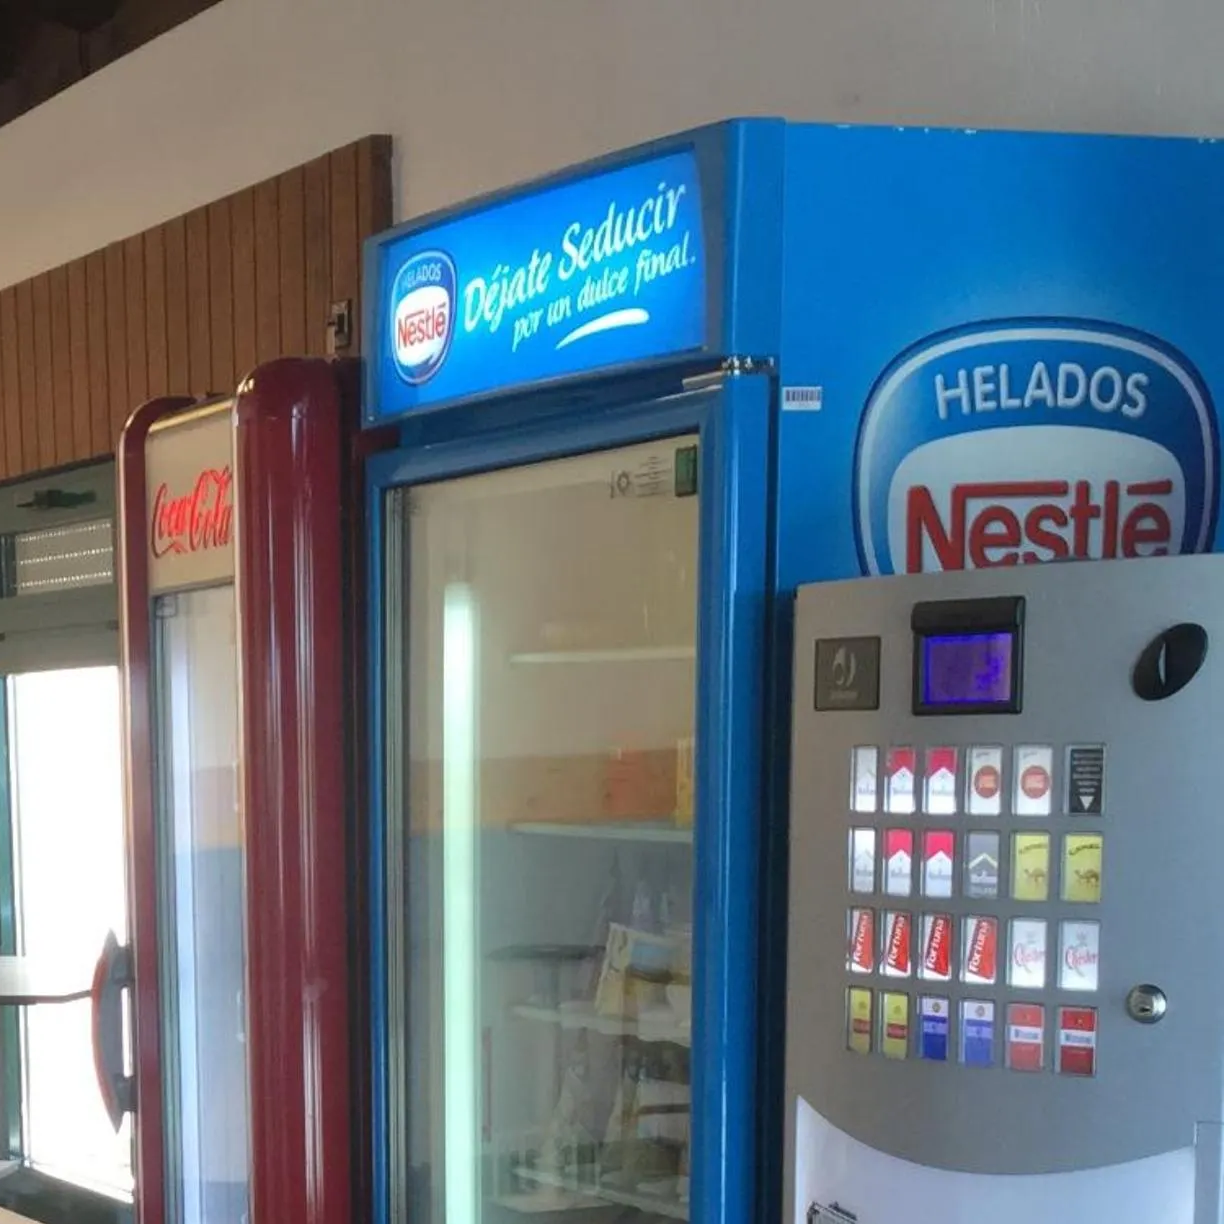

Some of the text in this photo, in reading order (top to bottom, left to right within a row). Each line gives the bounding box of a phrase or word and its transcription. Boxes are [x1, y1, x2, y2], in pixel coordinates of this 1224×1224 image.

[463, 181, 686, 333] Déjate Seducir
[512, 310, 542, 352] por
[547, 298, 572, 327] un
[577, 266, 628, 313] dulce
[934, 361, 1150, 420] HELADOS
